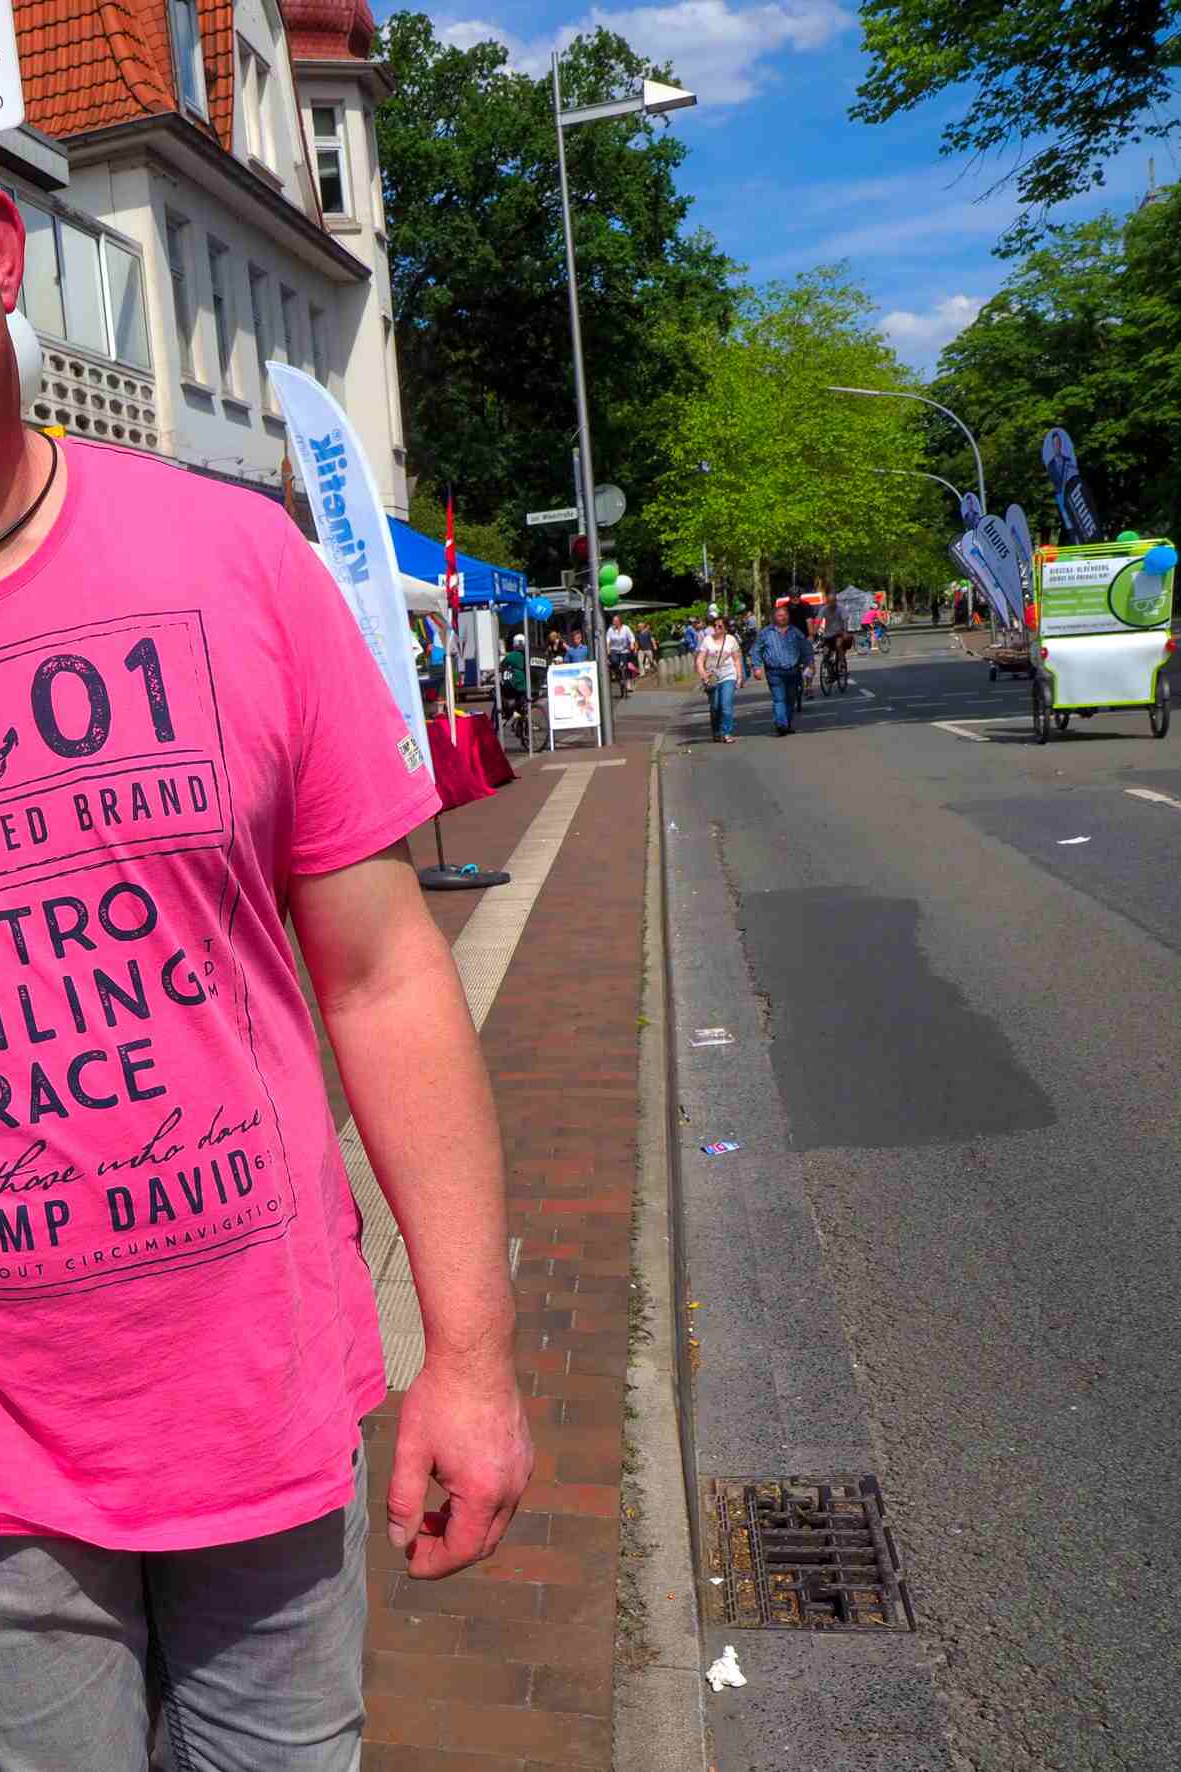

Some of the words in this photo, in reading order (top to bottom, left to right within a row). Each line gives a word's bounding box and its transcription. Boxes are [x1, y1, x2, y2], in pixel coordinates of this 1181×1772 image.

[983, 519, 1010, 560] bruns
[30, 636, 177, 759] 01
[76, 774, 210, 832] BRAND
[106, 1149, 254, 1233] DAVID
